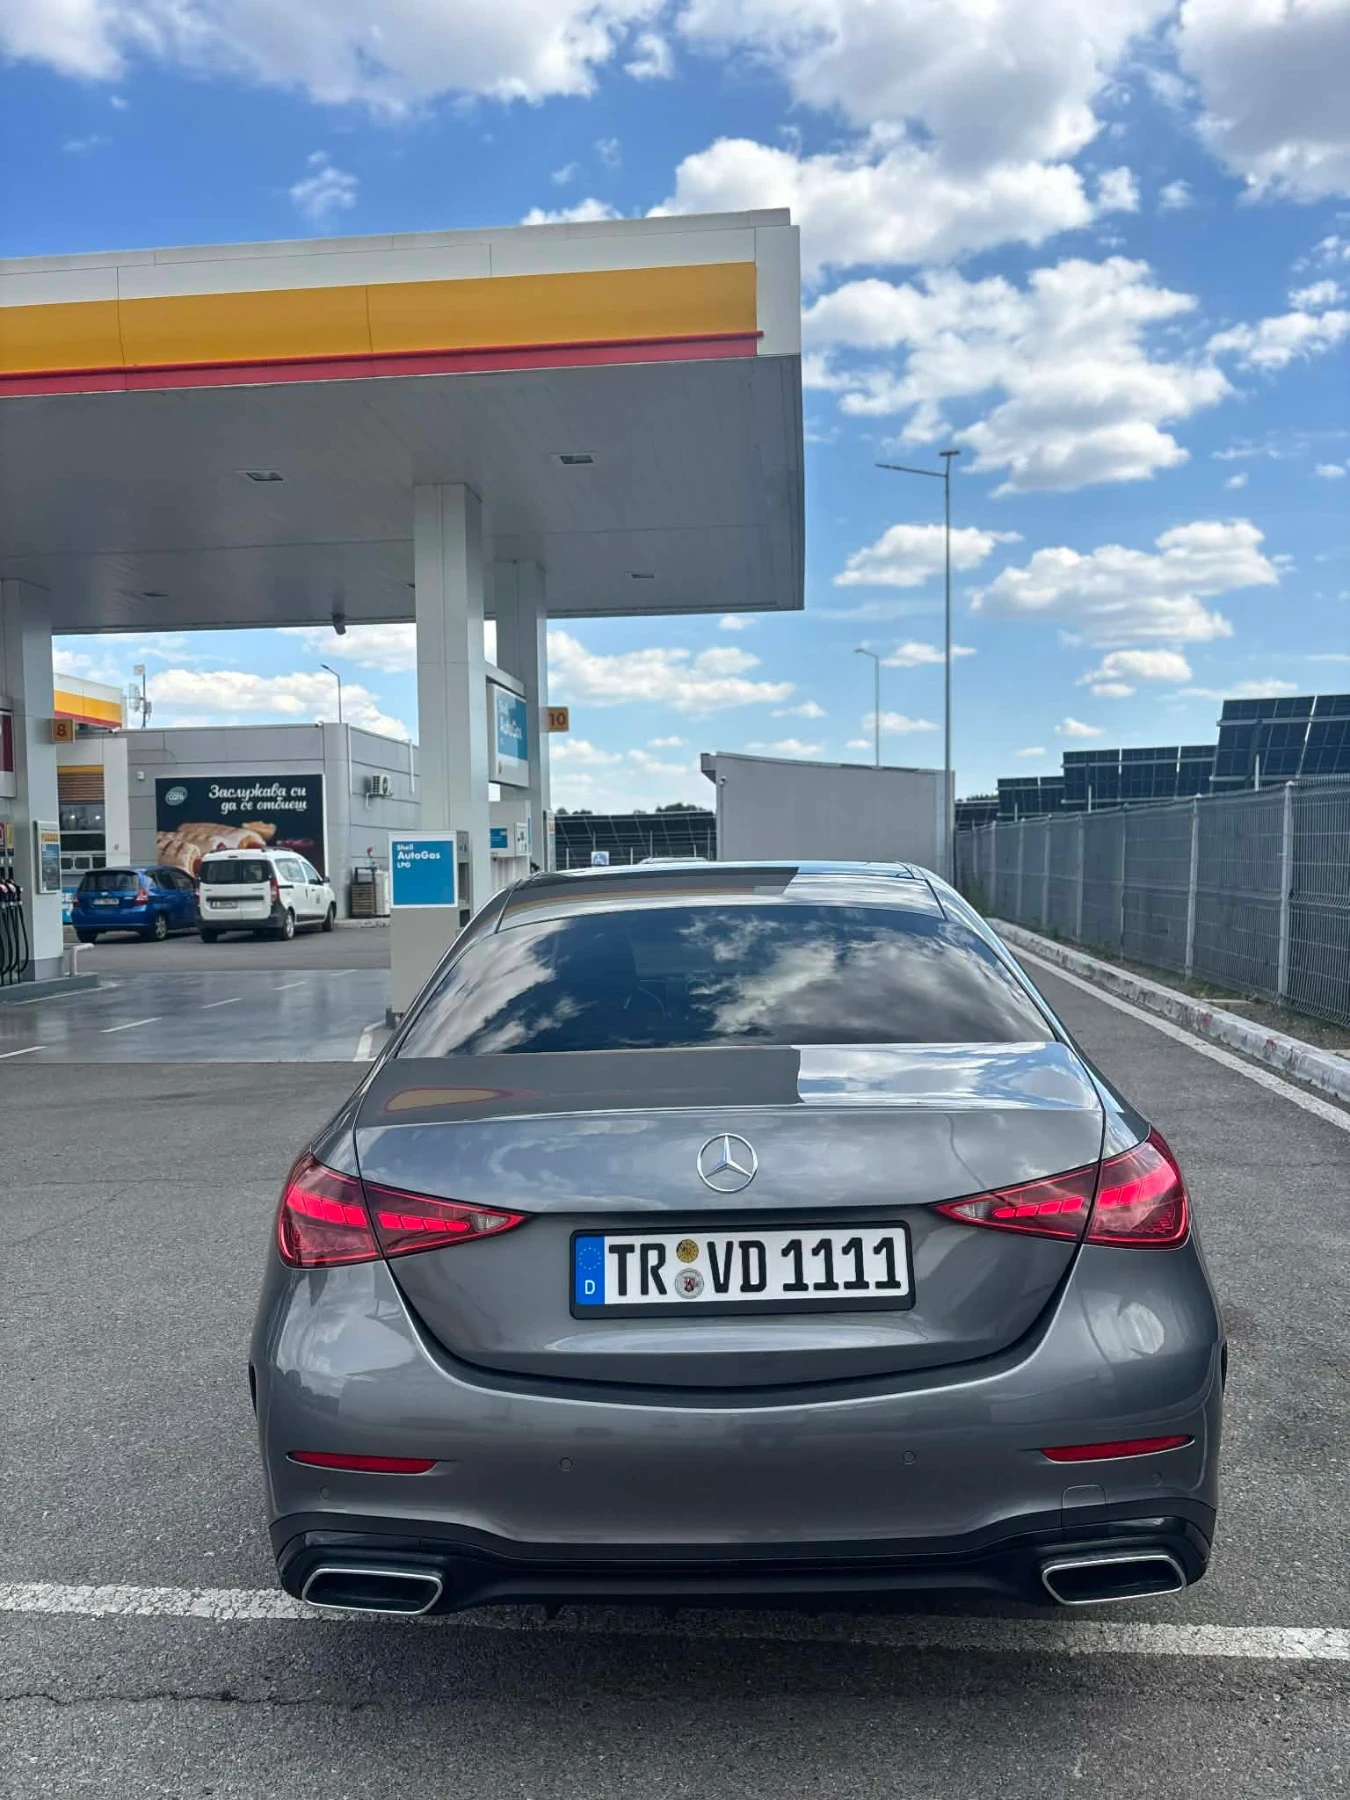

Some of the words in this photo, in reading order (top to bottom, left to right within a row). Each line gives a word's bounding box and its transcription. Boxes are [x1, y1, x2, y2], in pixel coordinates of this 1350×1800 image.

[548, 711, 567, 727] 10
[56, 723, 67, 737] 8
[208, 782, 287, 801] Заслужава
[290, 787, 307, 797] си
[220, 801, 237, 815] да
[240, 801, 254, 811] се
[256, 796, 308, 812] отбиеш
[397, 850, 441, 860] AutoGas
[397, 861, 412, 869] LPG
[608, 1242, 668, 1297] TR
[707, 1239, 767, 1294] VD
[781, 1236, 902, 1292] 1111
[584, 1279, 596, 1296] D
